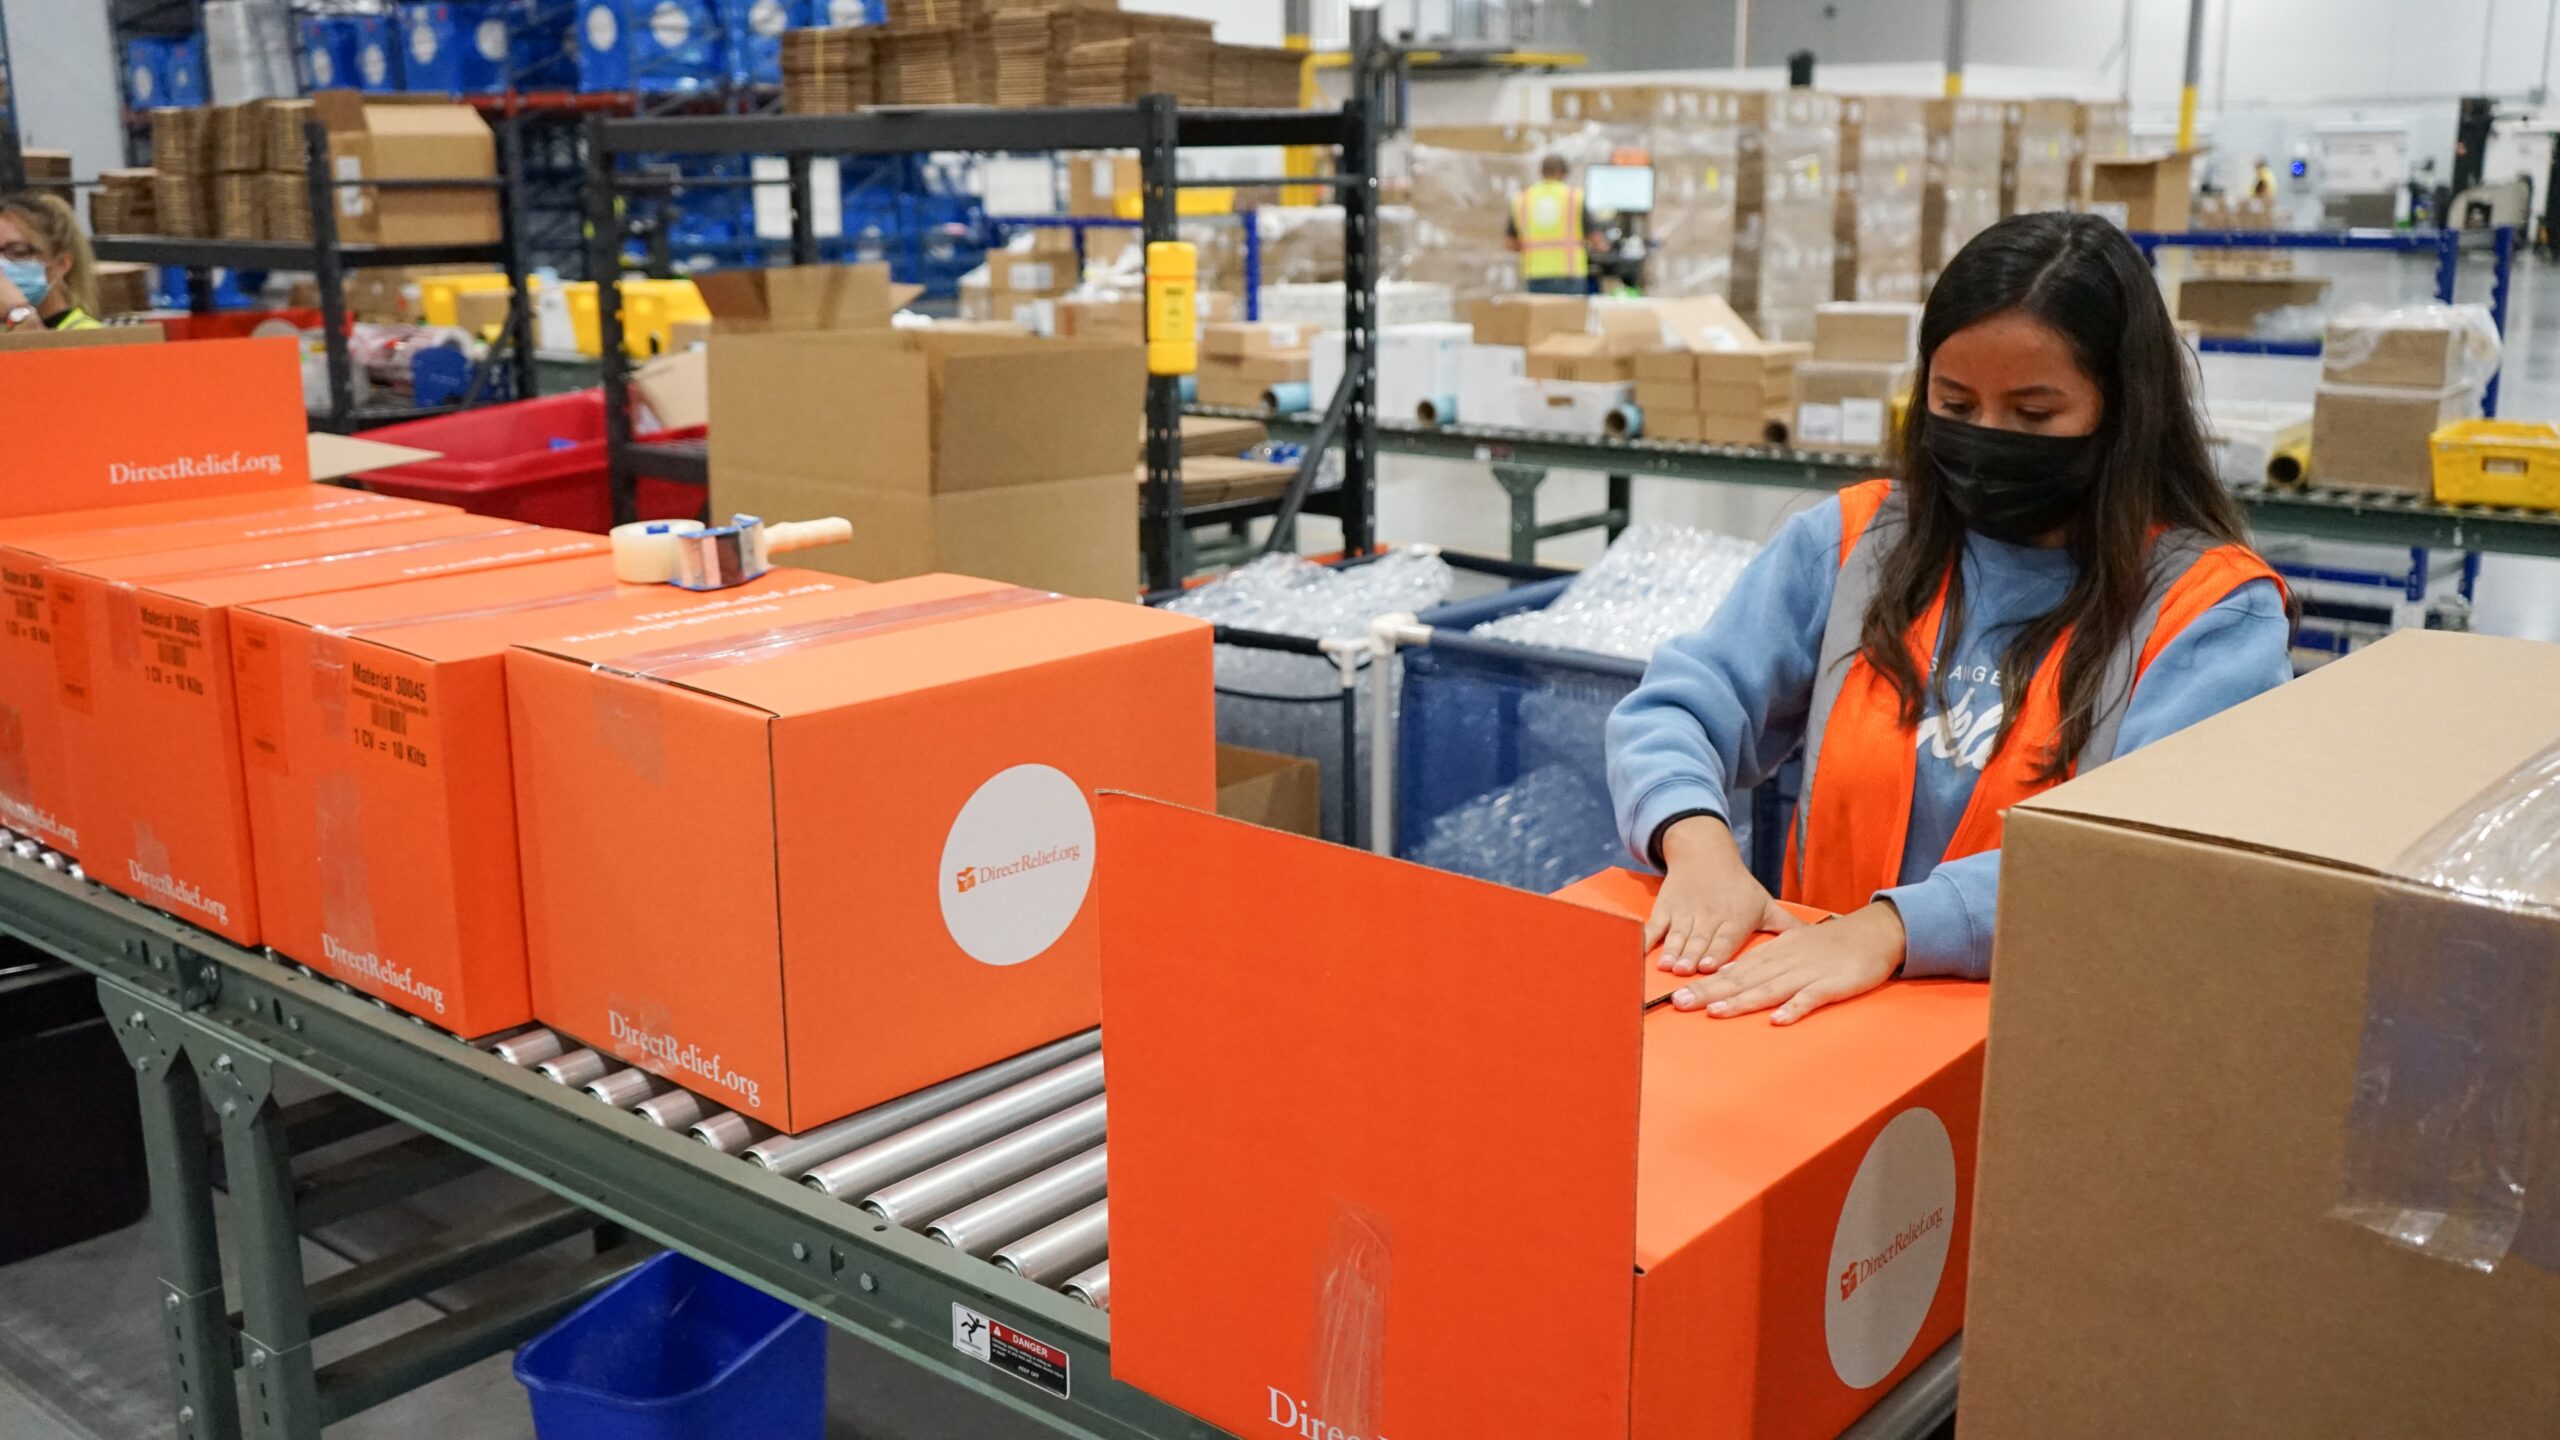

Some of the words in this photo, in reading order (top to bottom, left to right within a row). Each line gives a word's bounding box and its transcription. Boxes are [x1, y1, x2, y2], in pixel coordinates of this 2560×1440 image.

[109, 451, 282, 485] DirectRelief.org
[352, 661, 392, 692] Material
[395, 675, 427, 703] 30045
[353, 727, 359, 745] 1
[362, 729, 375, 750] CV
[379, 741, 387, 752] =
[393, 741, 404, 760] 10
[406, 744, 428, 768] Kits
[979, 844, 1081, 884] DirectRelief.org
[128, 859, 228, 926] DirectRelief.org
[322, 932, 446, 1015] DirectRelief.org
[608, 1009, 762, 1108] DirectRelief.org
[1859, 1206, 1943, 1284] DirectRelief.org
[1012, 1334, 1048, 1358] DANGER
